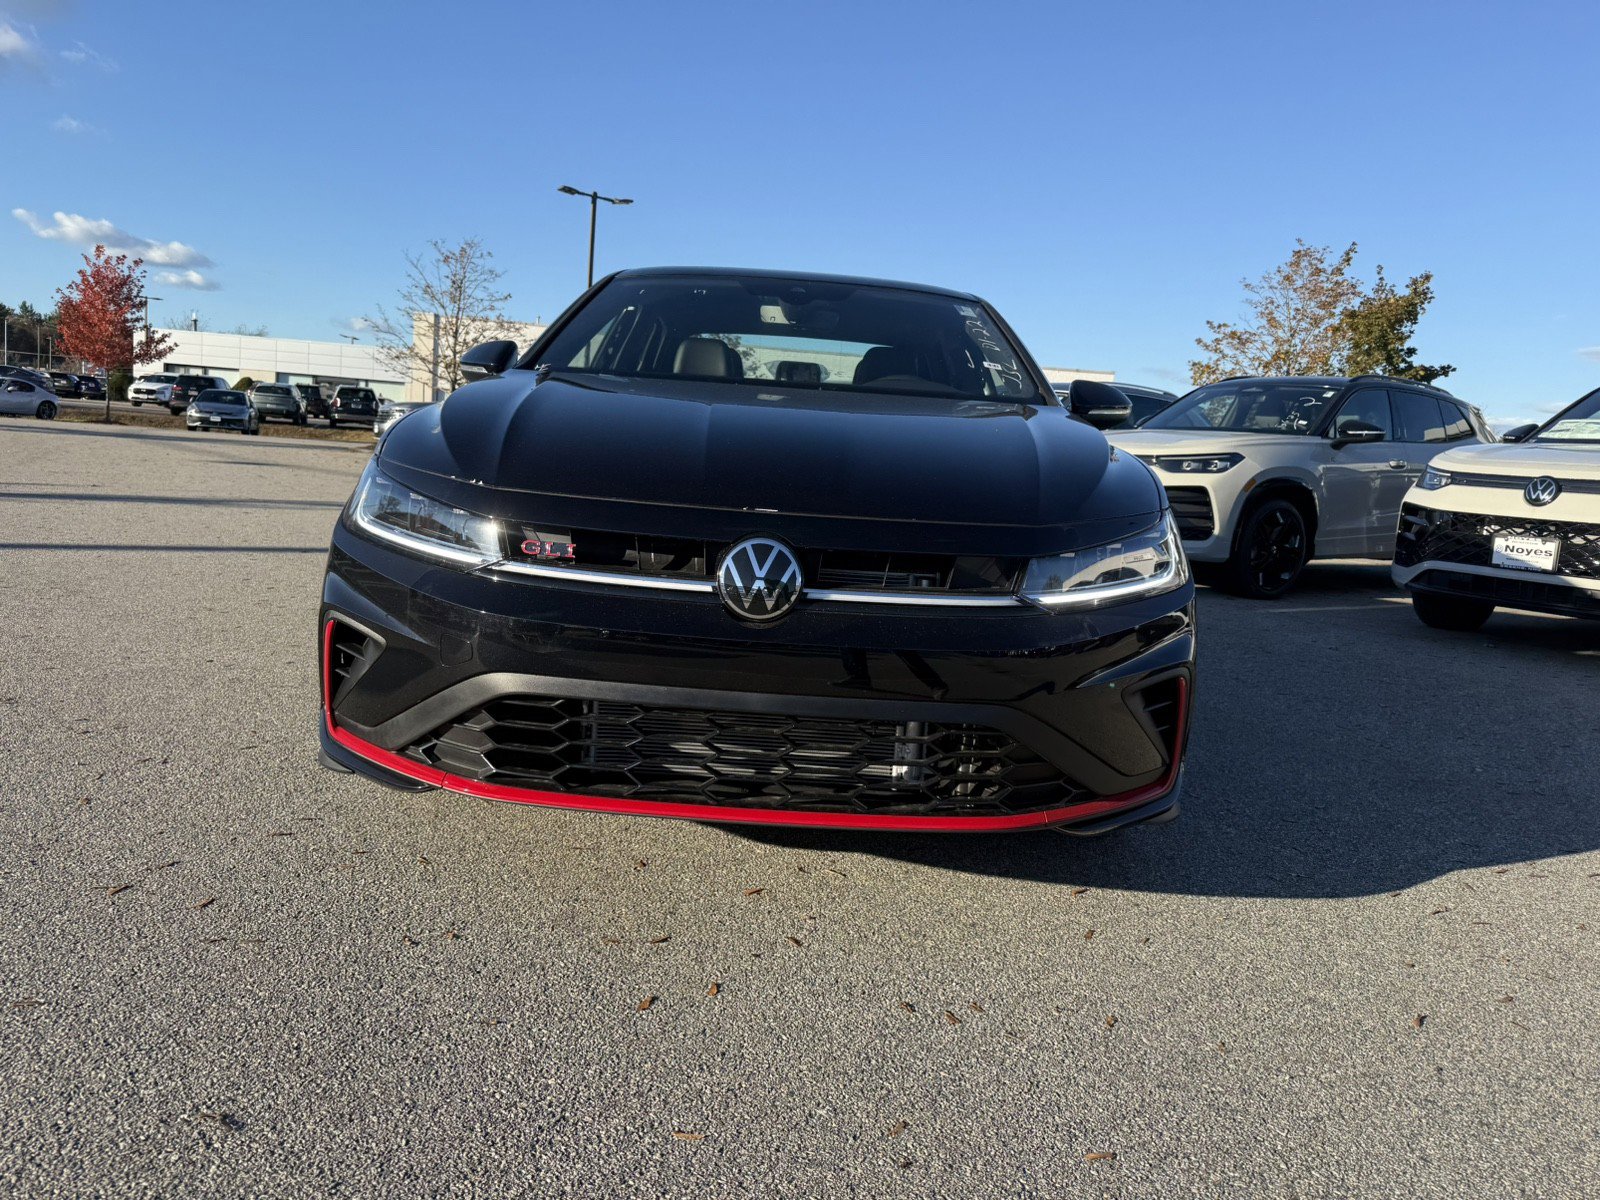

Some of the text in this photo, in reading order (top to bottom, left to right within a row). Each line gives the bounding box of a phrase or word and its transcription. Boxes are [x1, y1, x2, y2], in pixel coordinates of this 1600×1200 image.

[521, 539, 577, 558] GLI
[1504, 545, 1553, 557] Noyes
[721, 539, 800, 614] VW
